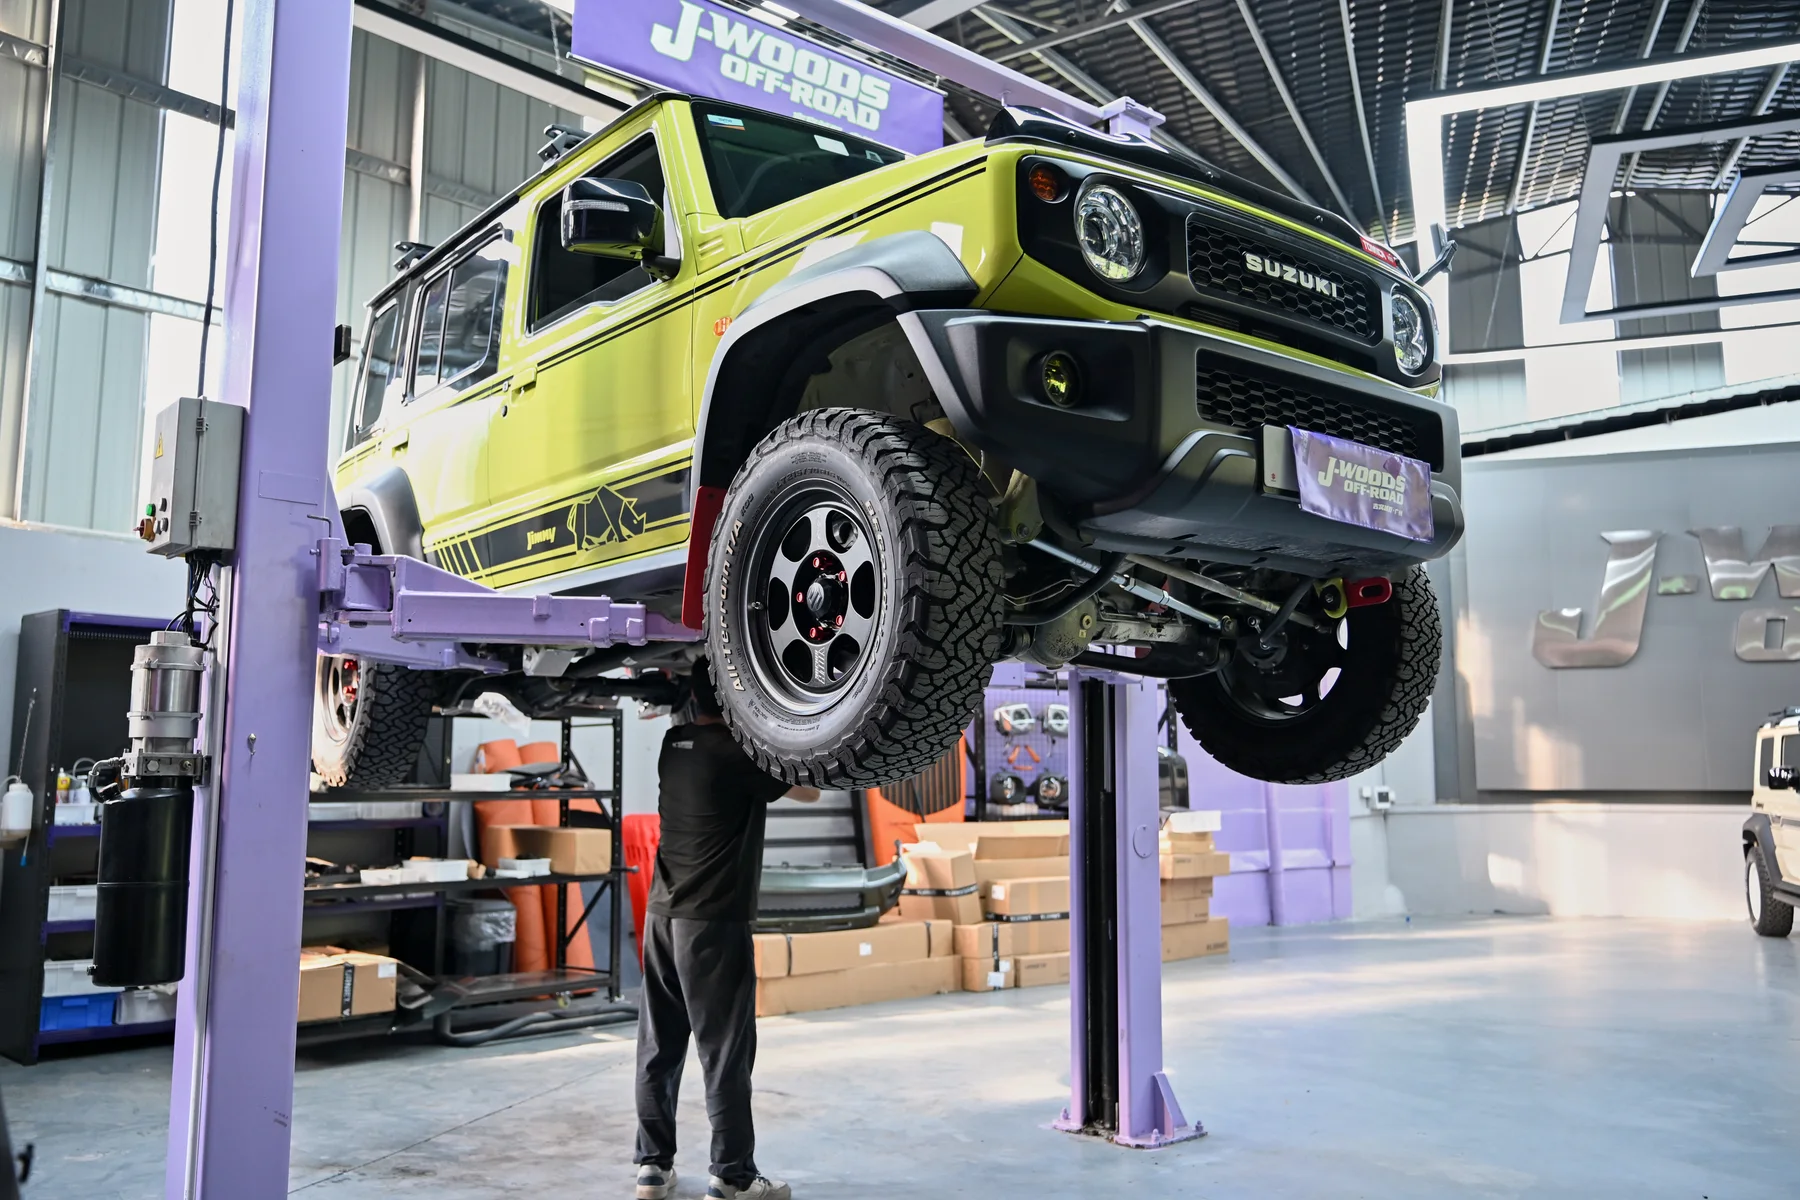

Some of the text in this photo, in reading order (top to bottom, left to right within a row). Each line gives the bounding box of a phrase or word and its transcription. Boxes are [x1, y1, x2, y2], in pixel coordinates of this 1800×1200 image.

[649, 0, 891, 112] J-WOODS
[719, 53, 881, 133] OFF-ROAD
[1244, 251, 1338, 299] SUZUKI
[1317, 456, 1406, 493] J-WOODS
[1343, 479, 1405, 506] OFF-ROAD
